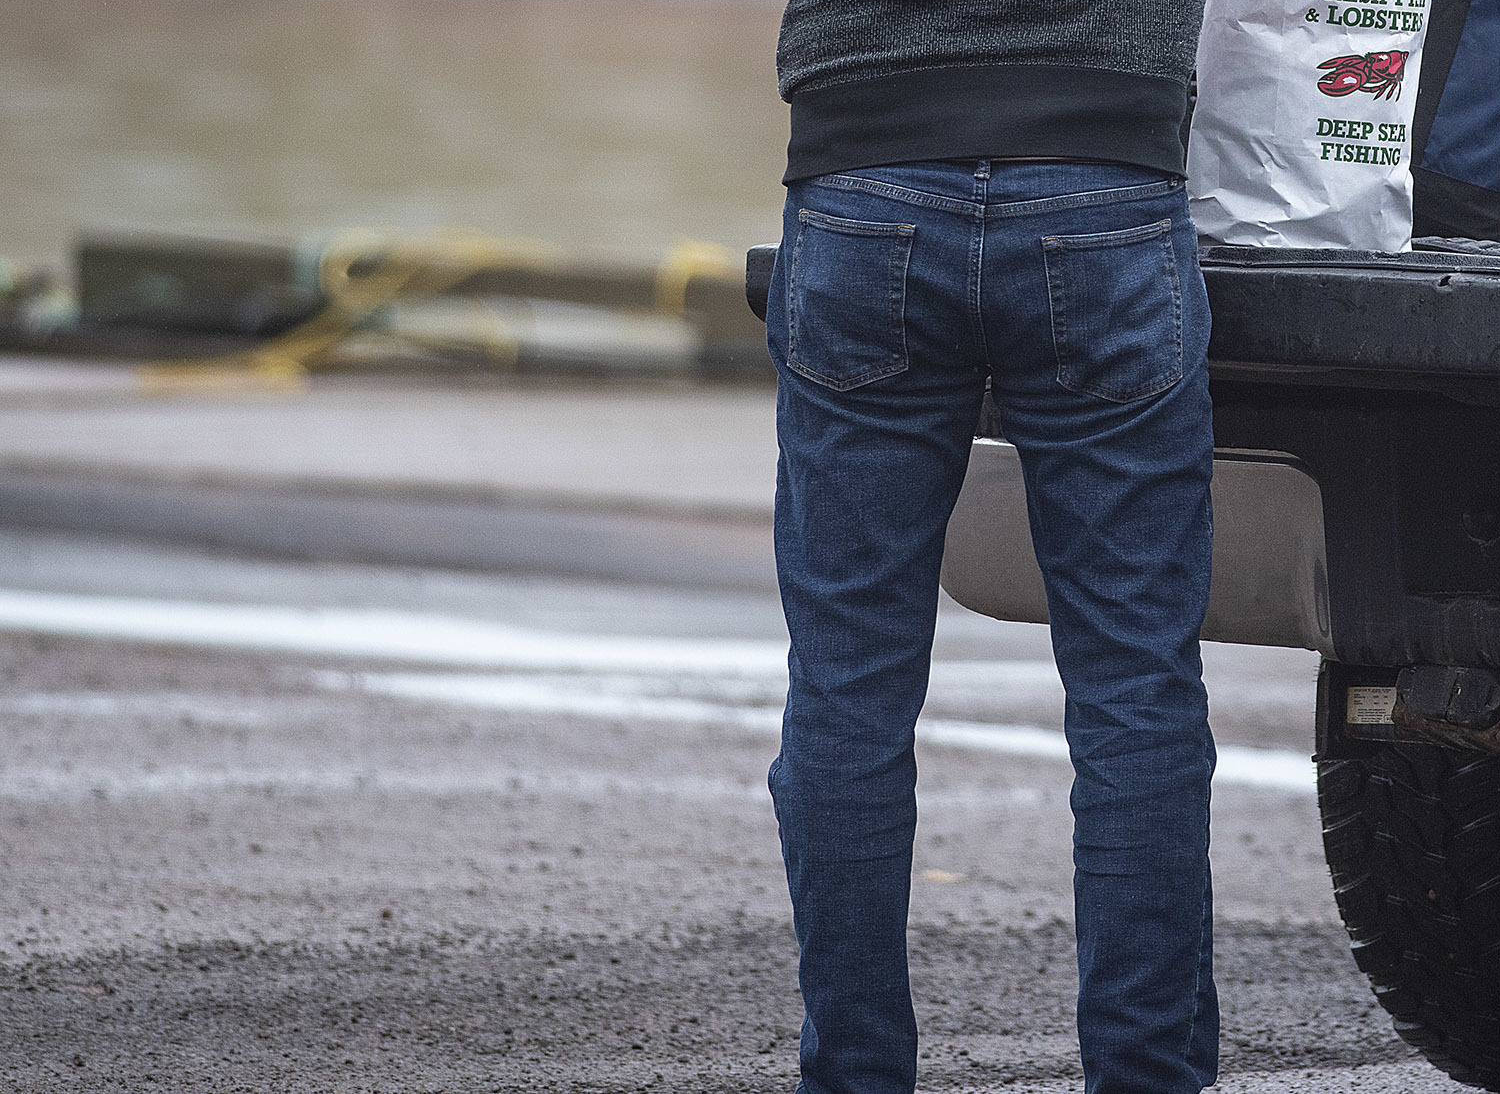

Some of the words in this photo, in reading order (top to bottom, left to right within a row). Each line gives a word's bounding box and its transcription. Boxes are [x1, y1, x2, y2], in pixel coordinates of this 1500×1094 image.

[1305, 7, 1320, 23] &
[1326, 4, 1424, 32] LOBSTERS
[1316, 117, 1374, 140] DEEP
[1378, 123, 1406, 143] SEA
[1320, 141, 1401, 166] FISHING
